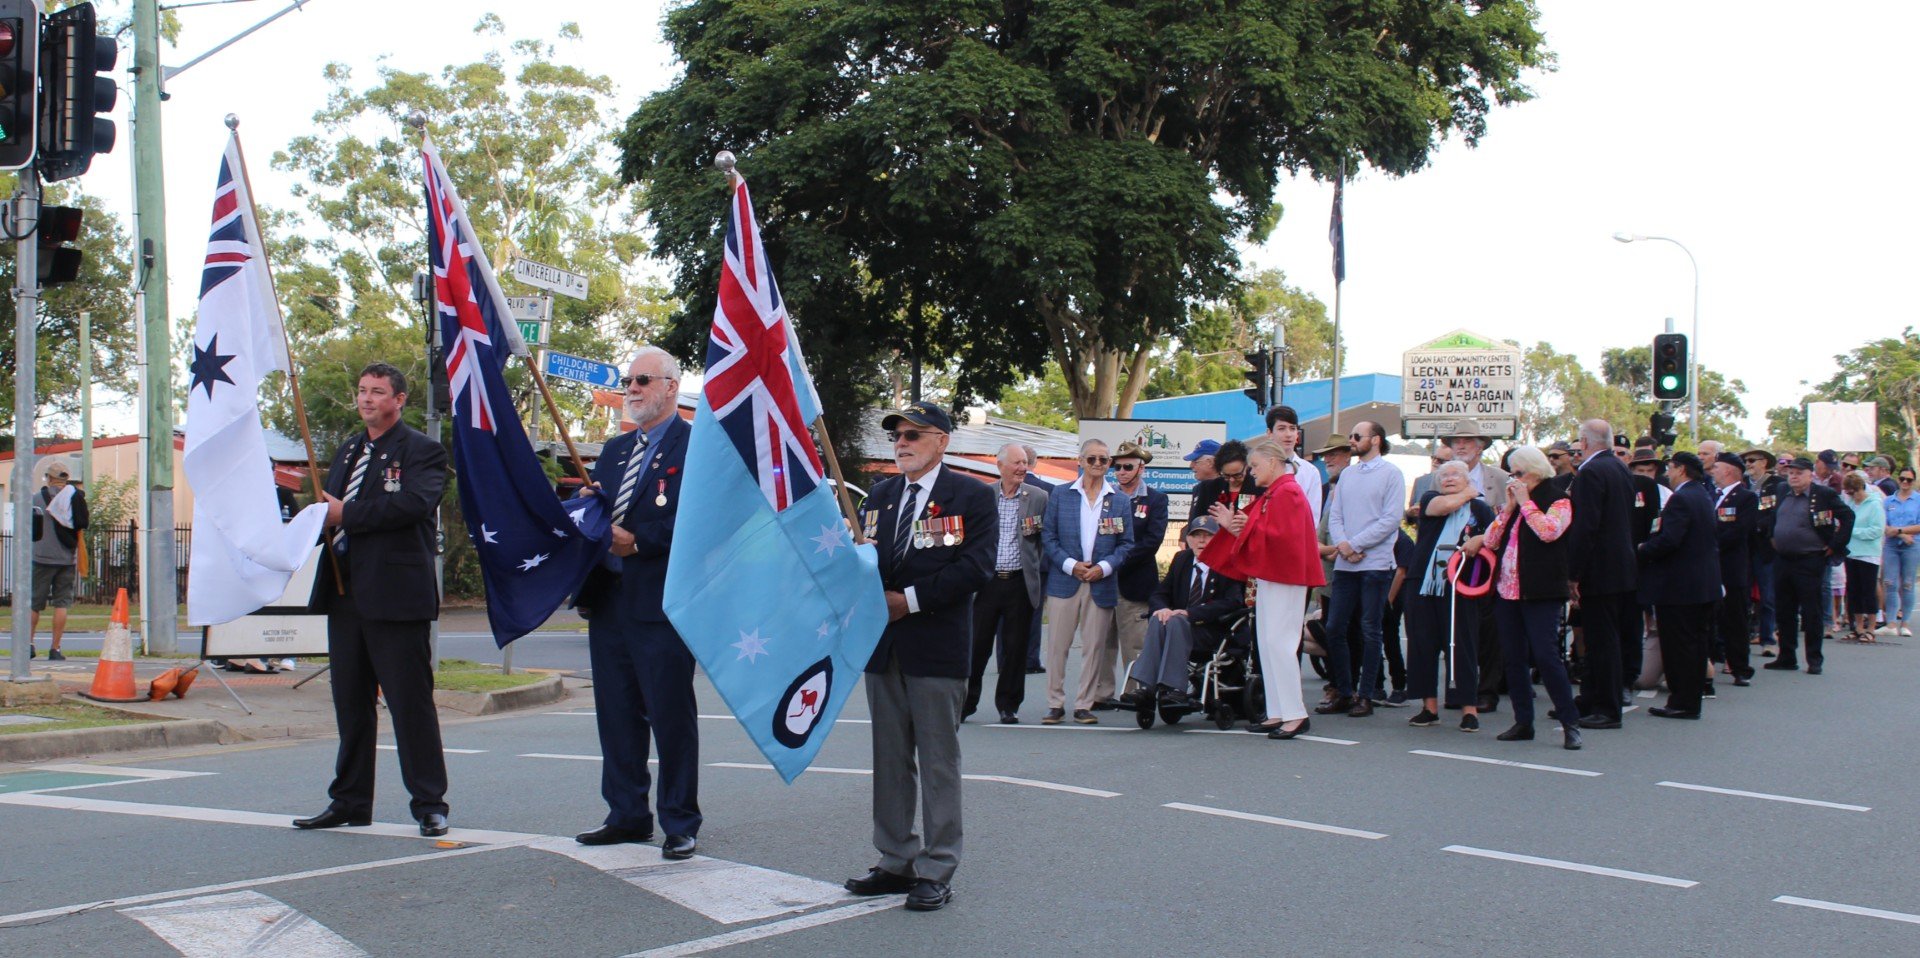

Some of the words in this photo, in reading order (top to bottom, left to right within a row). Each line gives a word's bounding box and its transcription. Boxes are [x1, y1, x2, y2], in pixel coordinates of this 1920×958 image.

[517, 260, 561, 284] CINDERELLA
[518, 323, 537, 342] CE
[551, 354, 599, 374] CHILDCARE
[1411, 356, 1432, 364] LOGAN
[1433, 356, 1447, 364] EAST
[1448, 355, 1487, 363] COMMUNITY
[1488, 355, 1510, 363] CENTRE
[557, 366, 590, 381] CENTRE
[1412, 366, 1450, 377] LECNA
[1456, 365, 1512, 376] MARKETS
[1420, 379, 1443, 389] 25th
[1449, 378, 1472, 389] MAY
[1419, 403, 1442, 413] FUN
[1446, 402, 1469, 413] DAY
[1477, 402, 1504, 413] OUT!
[1151, 471, 1196, 479] Communit
[1160, 481, 1196, 490] Associat
